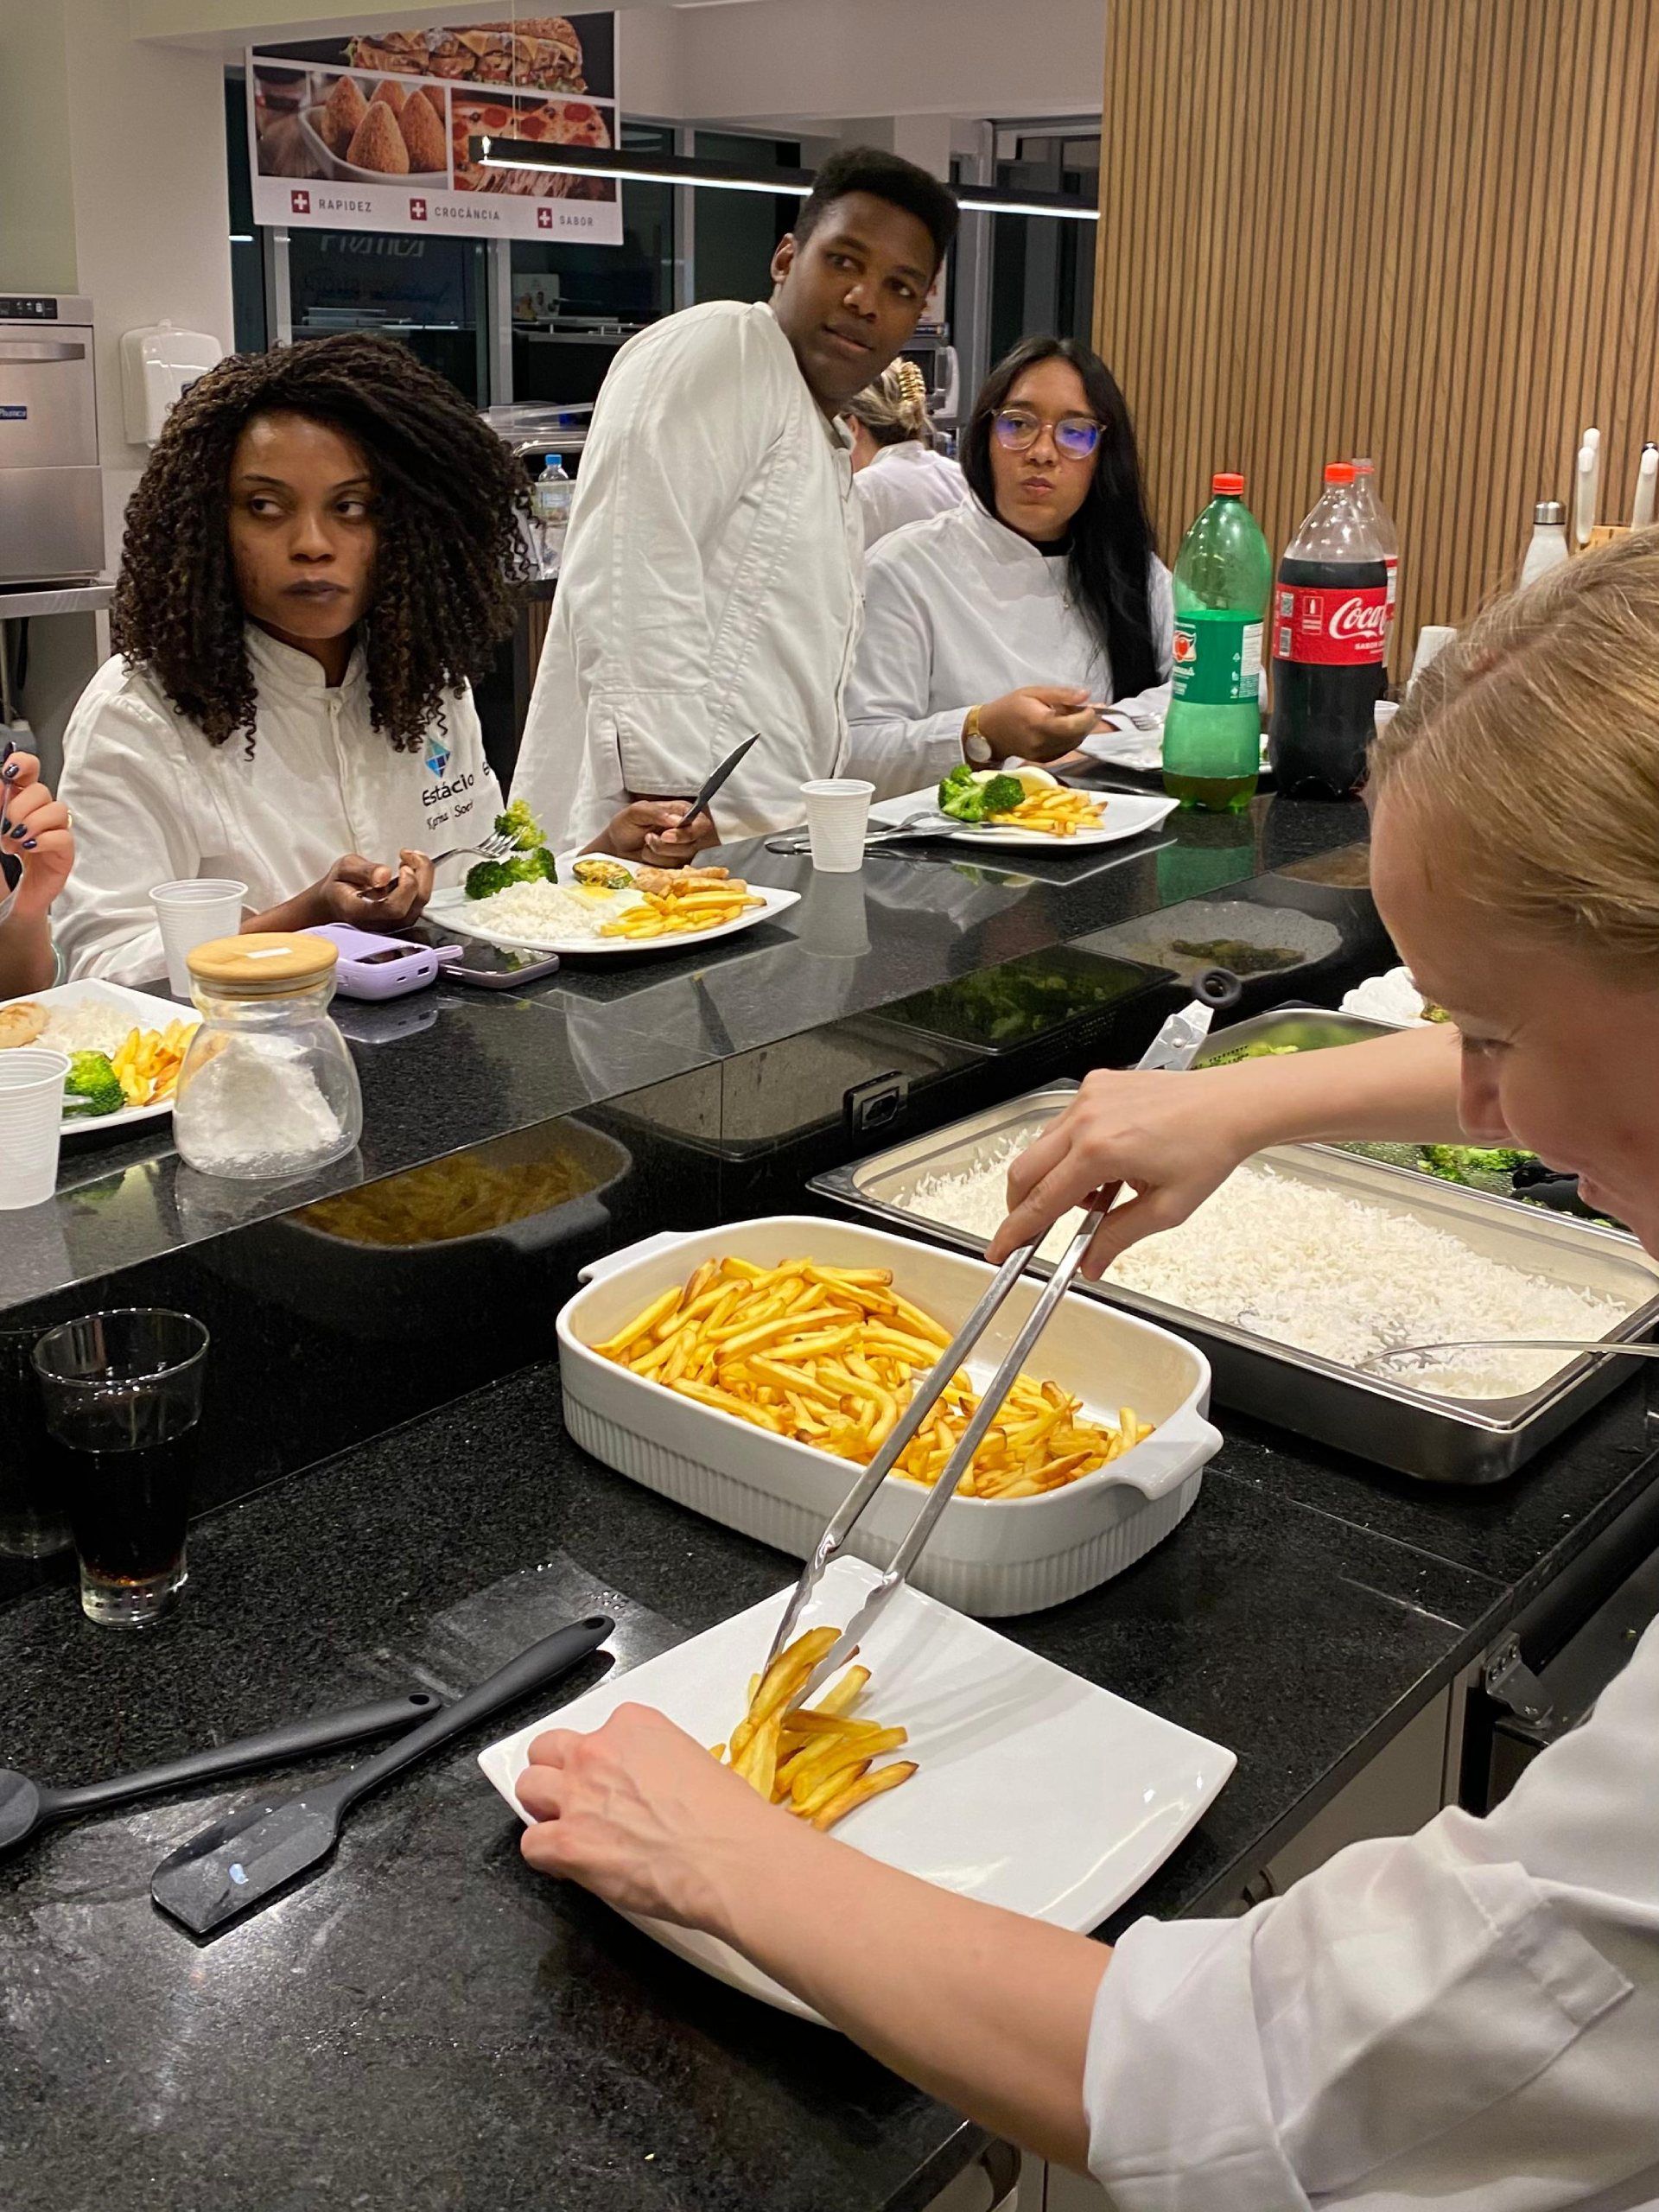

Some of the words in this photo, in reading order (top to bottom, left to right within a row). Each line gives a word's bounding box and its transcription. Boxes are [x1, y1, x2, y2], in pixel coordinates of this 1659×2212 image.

[319, 199, 372, 213] RAPIDEZ
[435, 206, 500, 220] CROCÂNCIA
[560, 215, 594, 226] SABOR
[1329, 596, 1386, 639] Coca
[423, 774, 474, 807] Estácio
